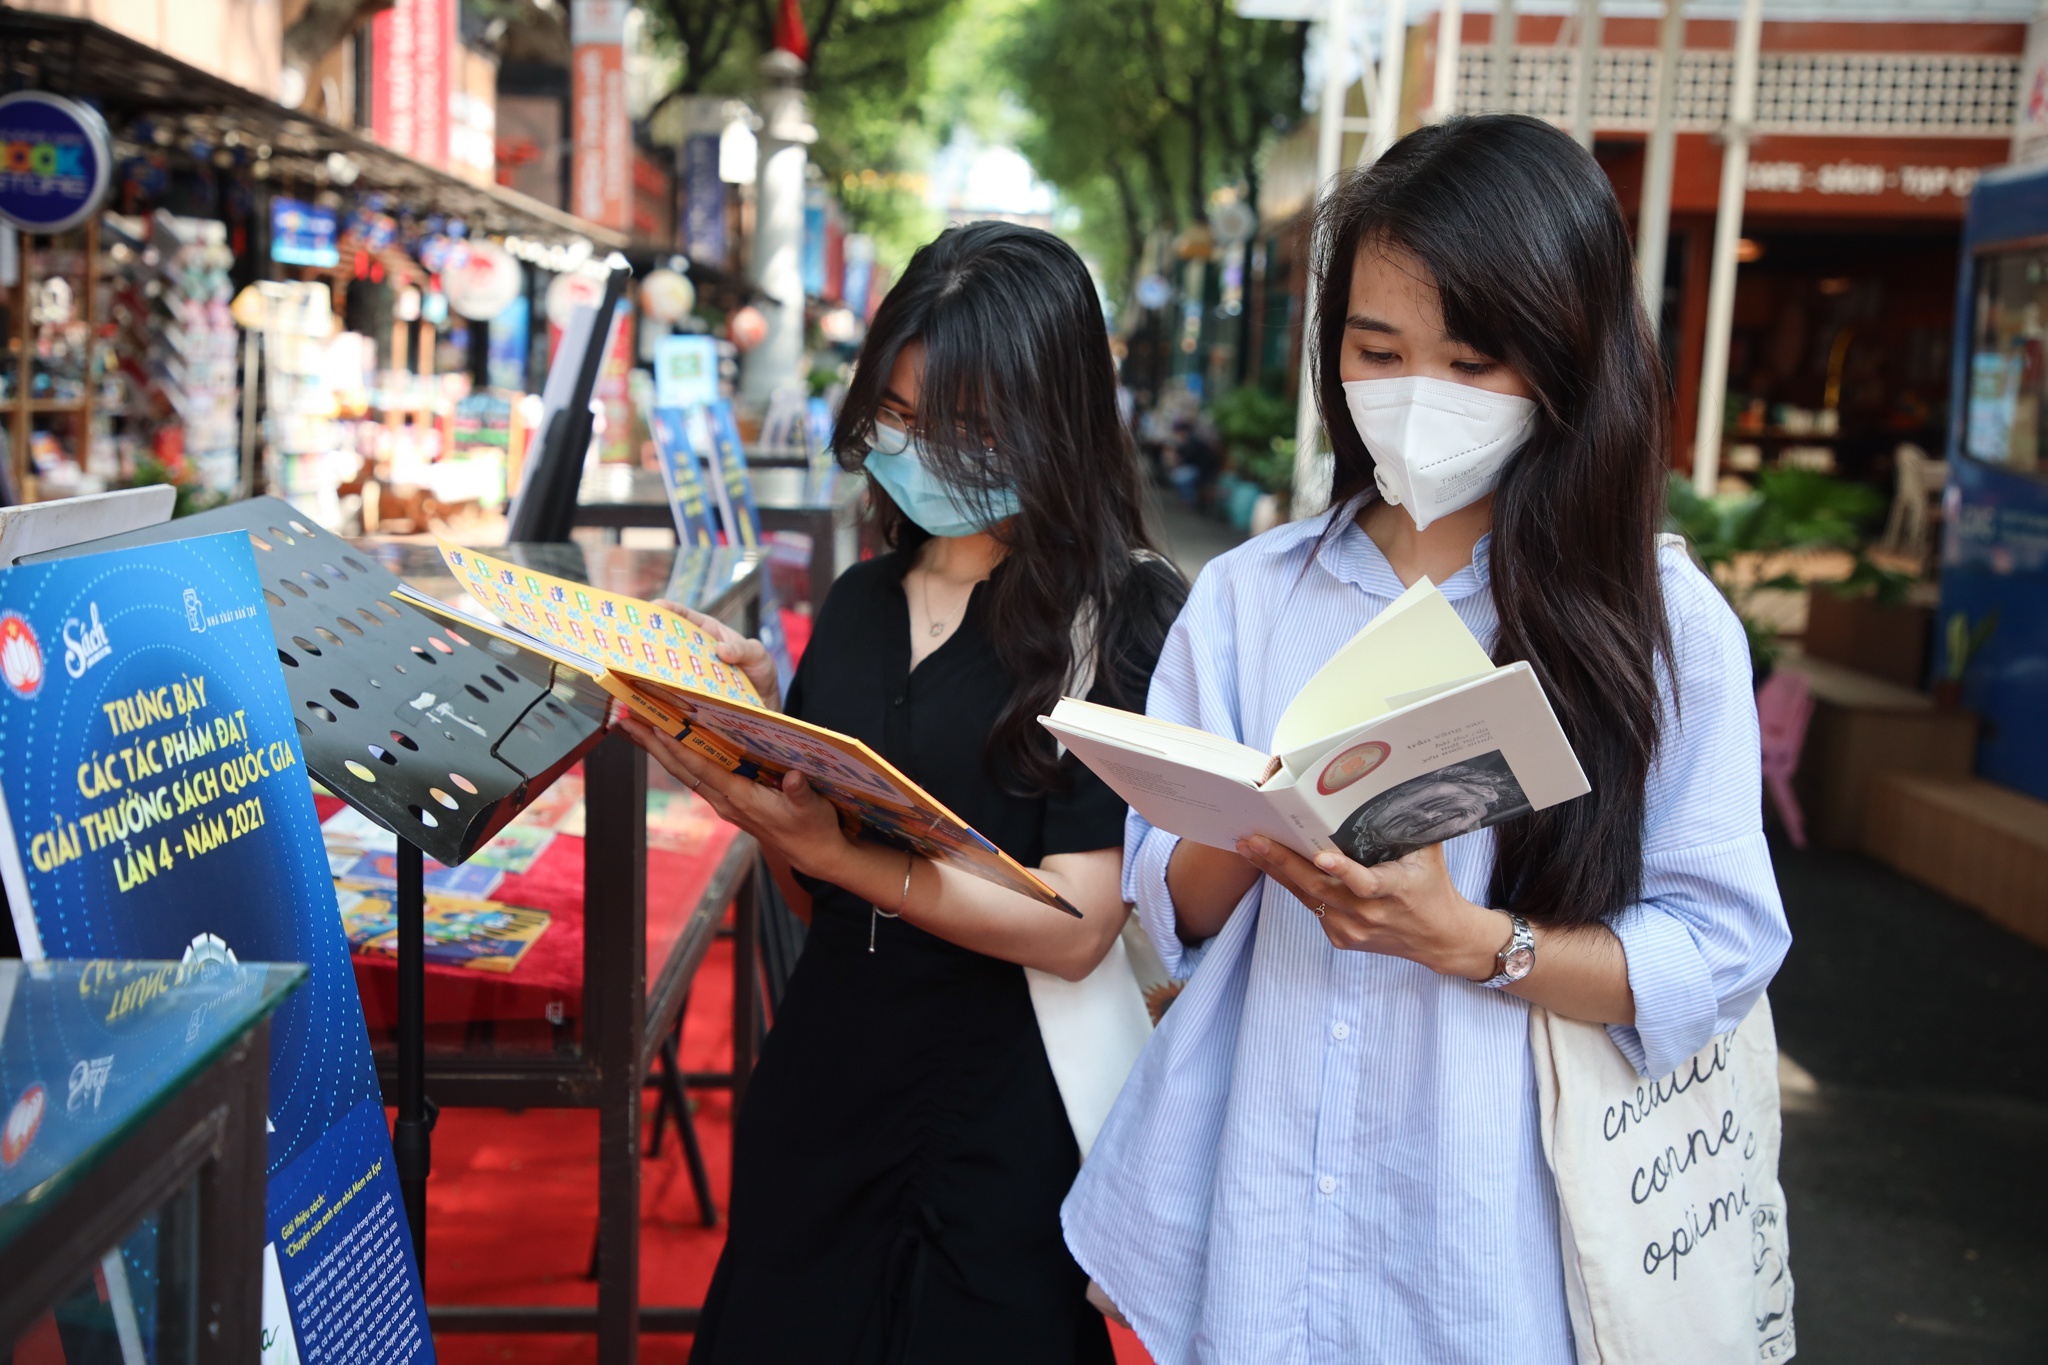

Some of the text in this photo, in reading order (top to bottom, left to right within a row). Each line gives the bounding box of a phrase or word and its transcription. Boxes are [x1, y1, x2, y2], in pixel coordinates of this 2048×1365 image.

[0, 141, 85, 178] OOK
[62, 601, 109, 679] Sách
[103, 673, 208, 737] TRƯNG BÀY
[77, 710, 248, 799] CÁC TÁC PHẨM ĐẠT
[31, 739, 296, 873] GIẢI THƯỞNG SÁCH QUỐC GIA
[113, 838, 157, 893] LẦN
[159, 838, 173, 870] 4
[184, 813, 230, 859] NĂM
[228, 797, 265, 838] 2021
[281, 1220, 294, 1239] Giới
[294, 1209, 310, 1228] thiệu
[311, 1220, 322, 1235] của
[322, 1207, 333, 1224] anh
[333, 1200, 342, 1214] em
[352, 1177, 365, 1195] Mem
[301, 1315, 310, 1328] cho
